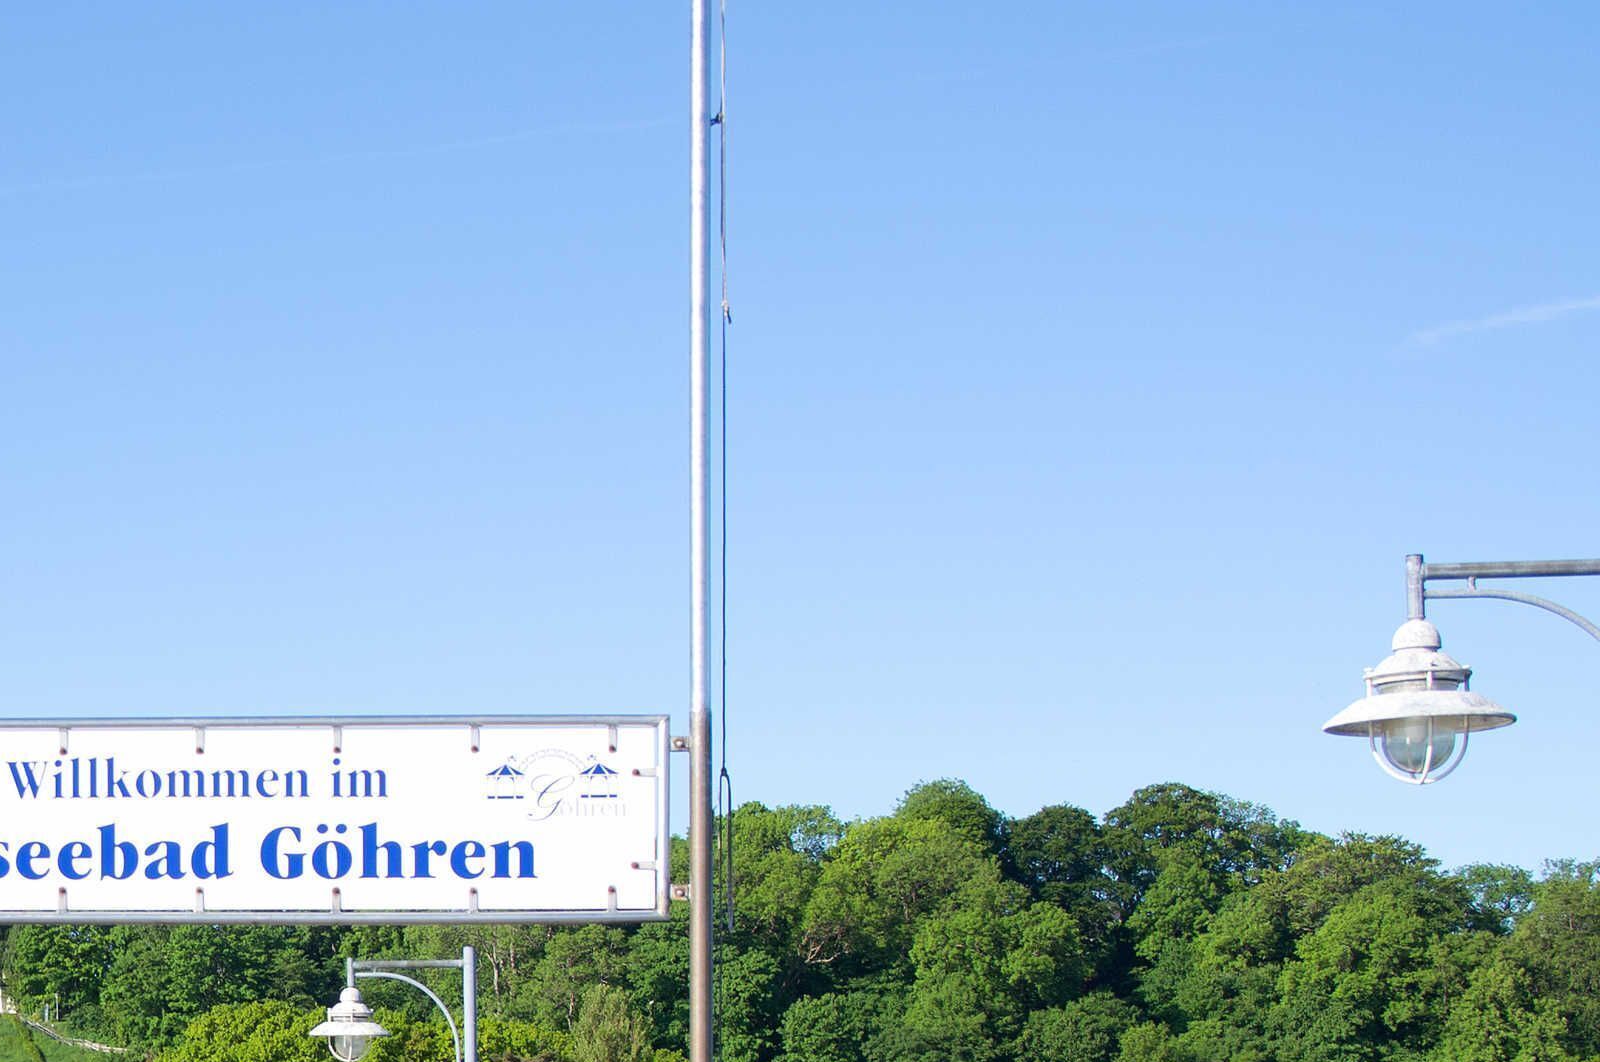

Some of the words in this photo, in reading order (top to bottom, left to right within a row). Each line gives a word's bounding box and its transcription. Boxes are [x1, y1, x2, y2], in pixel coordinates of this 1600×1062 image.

[8, 757, 309, 799] Willkommen
[332, 758, 388, 799] im
[260, 822, 538, 881] Göhren
